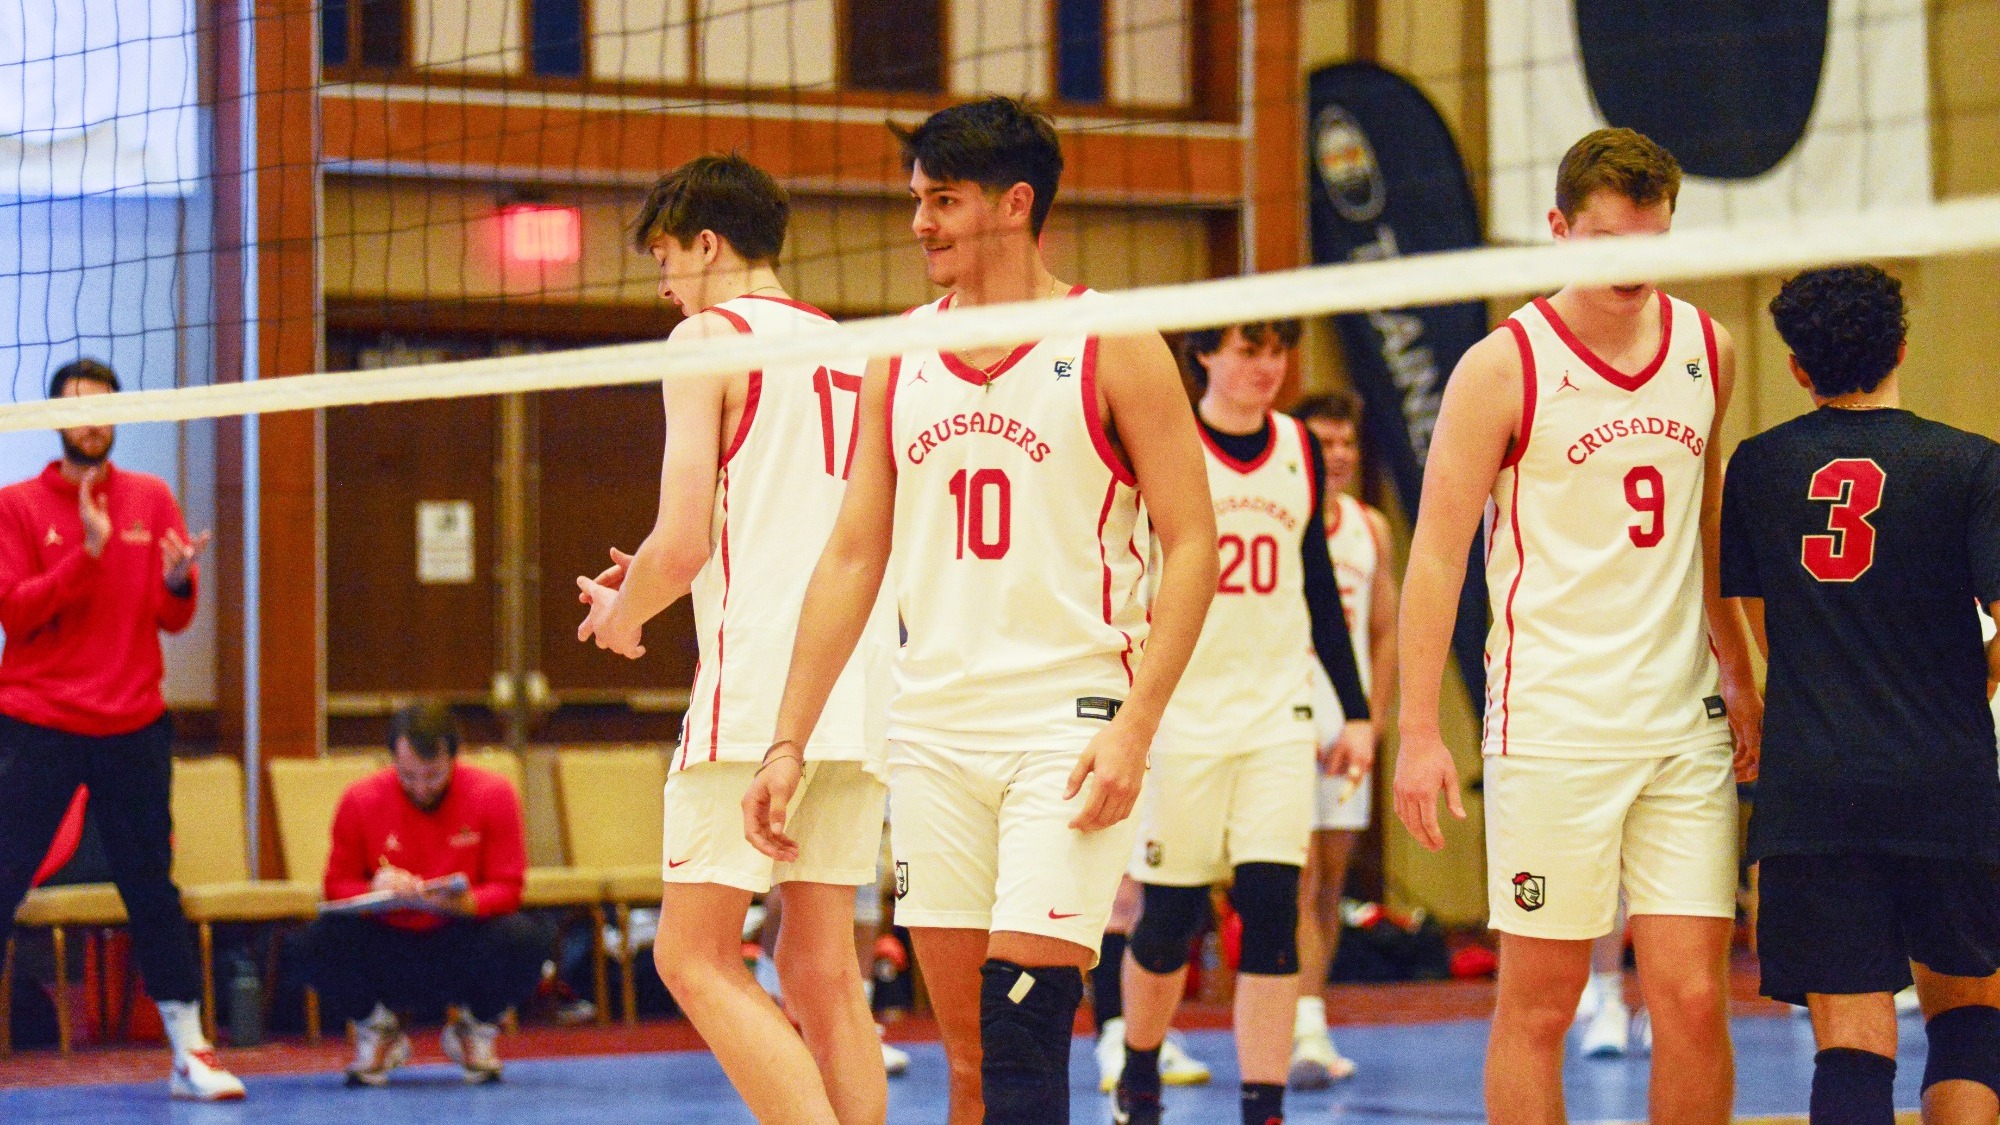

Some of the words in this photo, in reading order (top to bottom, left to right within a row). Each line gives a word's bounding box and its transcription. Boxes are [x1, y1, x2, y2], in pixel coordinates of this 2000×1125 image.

[813, 365, 862, 481] 17
[907, 412, 1051, 465] CRUSADERS
[1567, 417, 1704, 465] CRUSADERS
[949, 468, 1011, 560] 10
[1214, 496, 1297, 532] USADERS
[1623, 465, 1665, 548] 9
[1802, 458, 1886, 582] 3
[1217, 533, 1278, 595] 20
